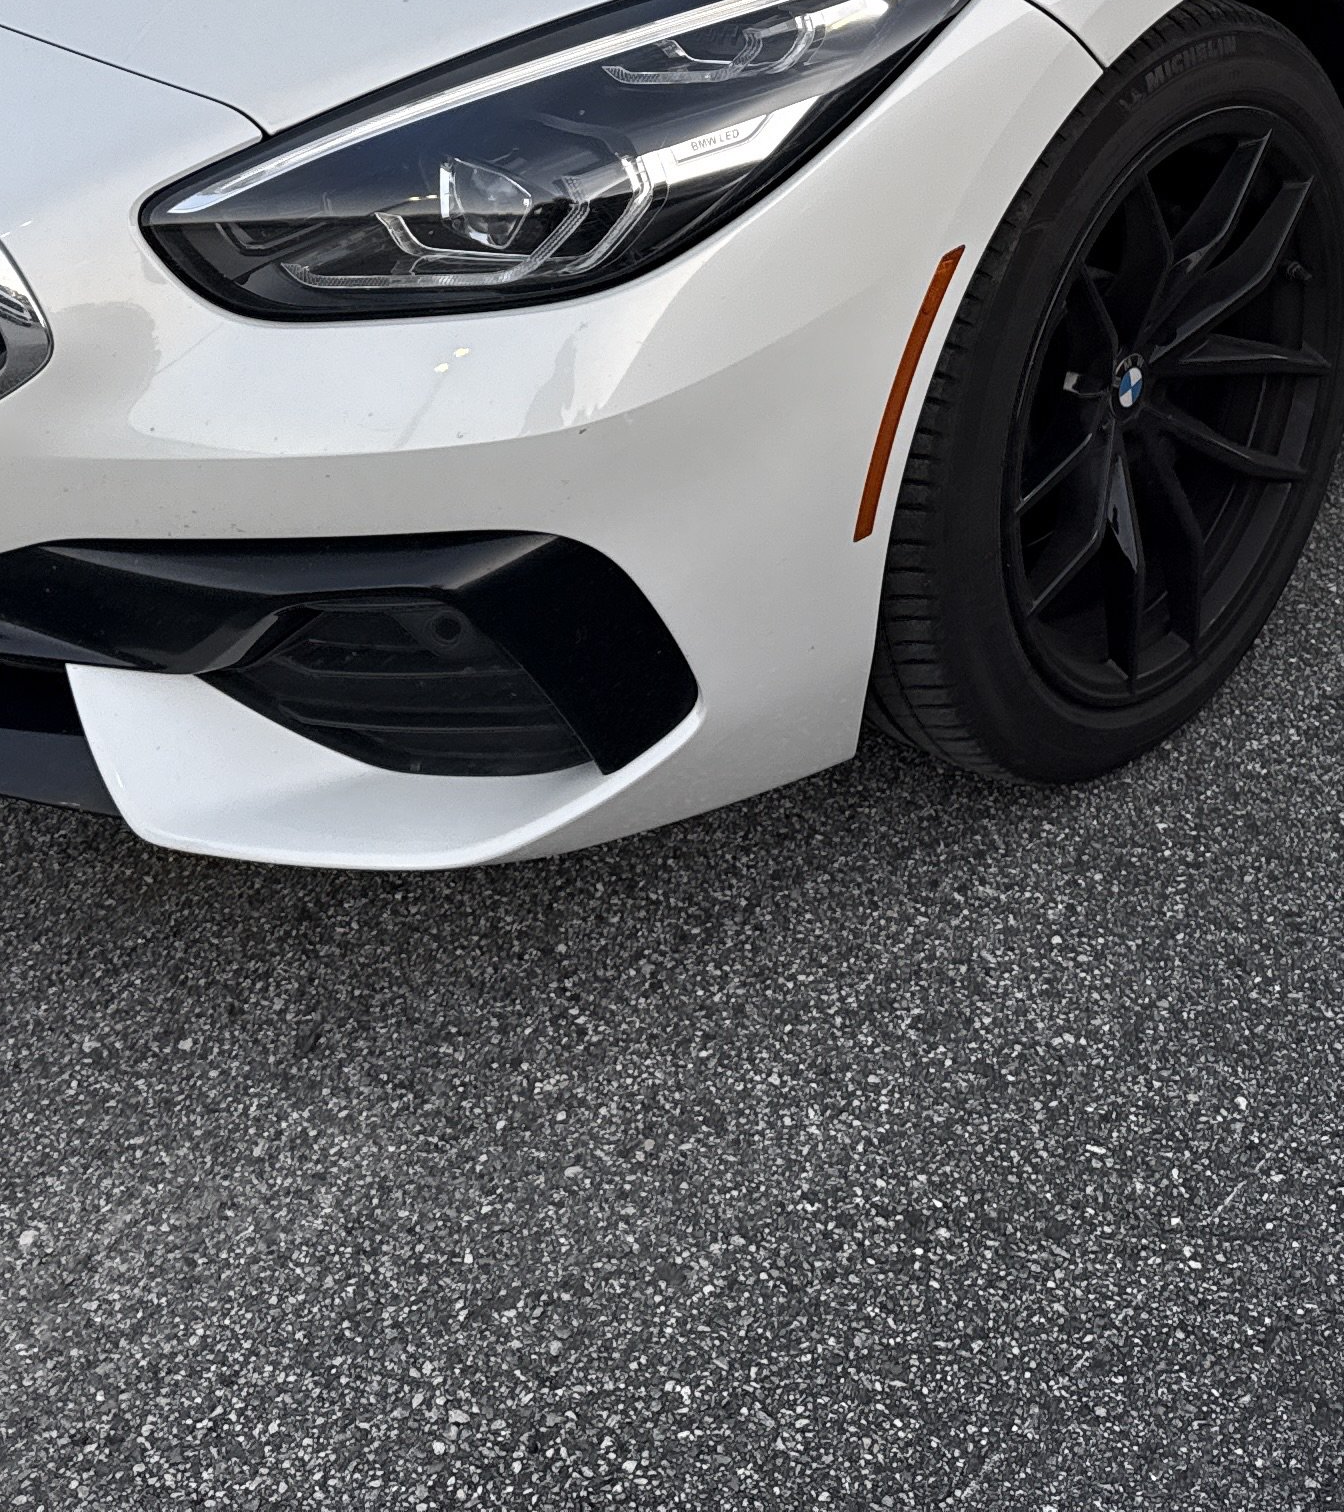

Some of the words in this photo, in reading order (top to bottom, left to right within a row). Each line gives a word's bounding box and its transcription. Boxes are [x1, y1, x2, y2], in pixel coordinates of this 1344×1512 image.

[1144, 34, 1237, 94] MICHELIN
[691, 137, 717, 151] BMW
[719, 129, 740, 143] LED
